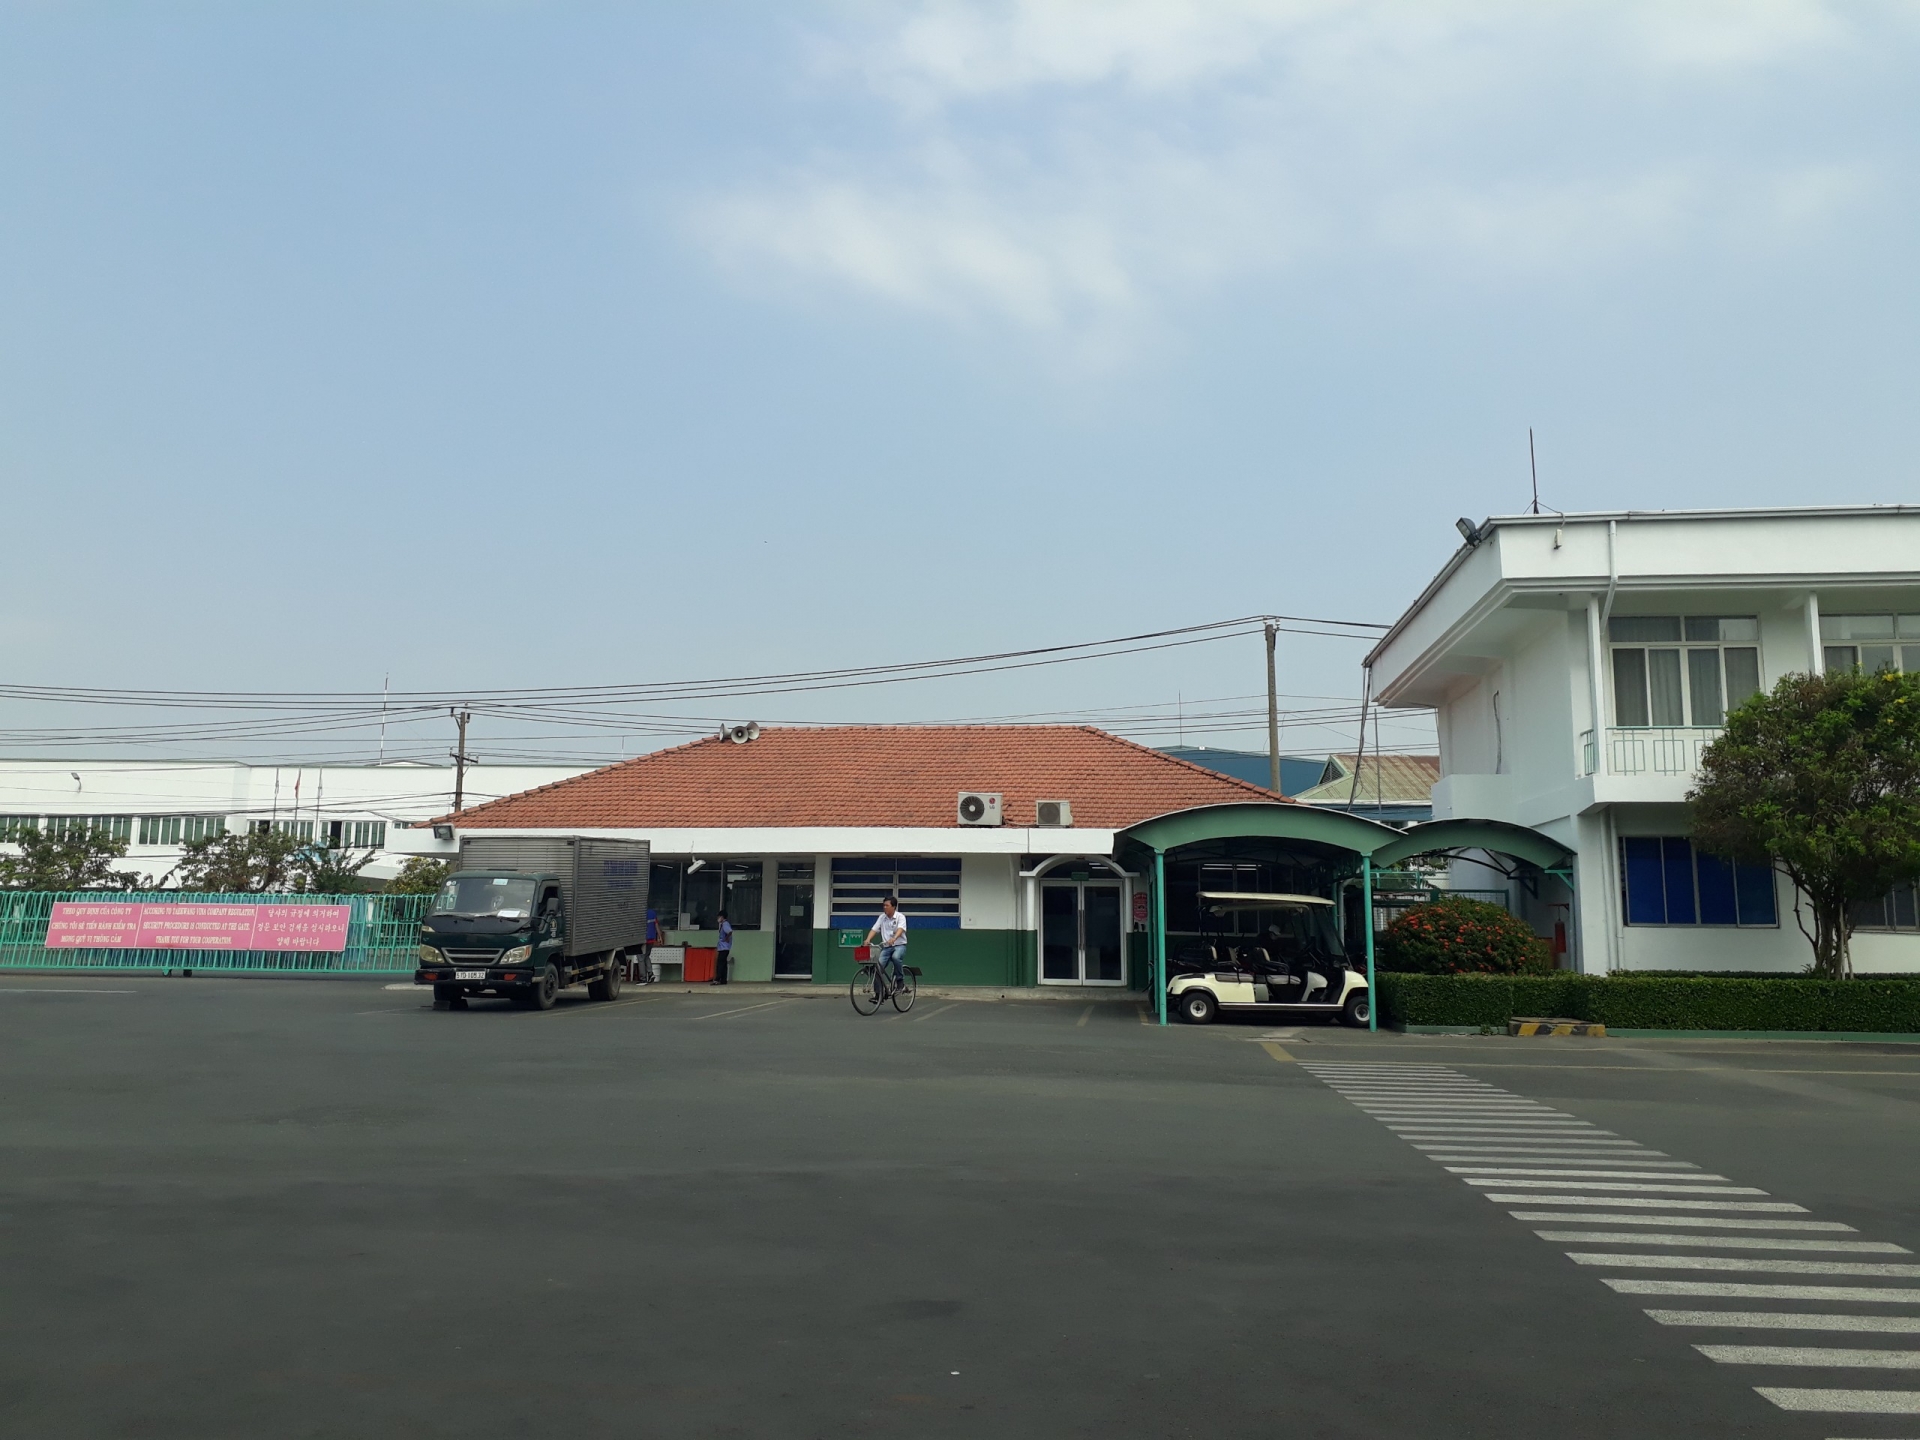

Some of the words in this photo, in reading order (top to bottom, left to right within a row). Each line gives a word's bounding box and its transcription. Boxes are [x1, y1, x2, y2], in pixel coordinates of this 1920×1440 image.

[76, 907, 86, 916] QUY
[110, 906, 124, 915] CÔNG
[125, 907, 132, 915] TY
[196, 907, 206, 915] VINA
[268, 908, 288, 918] 당사의
[290, 908, 310, 918] 규정에
[312, 908, 340, 918] 의거하여
[51, 921, 68, 930] CHÚNG
[70, 920, 78, 930] TÔI
[143, 922, 164, 930] SECURITY
[258, 922, 270, 932] 정문
[272, 923, 286, 932] 보안
[289, 923, 308, 932] 검색을
[311, 923, 344, 932] 실시하오니
[92, 934, 110, 942] THÔNG
[277, 937, 290, 946] 양해
